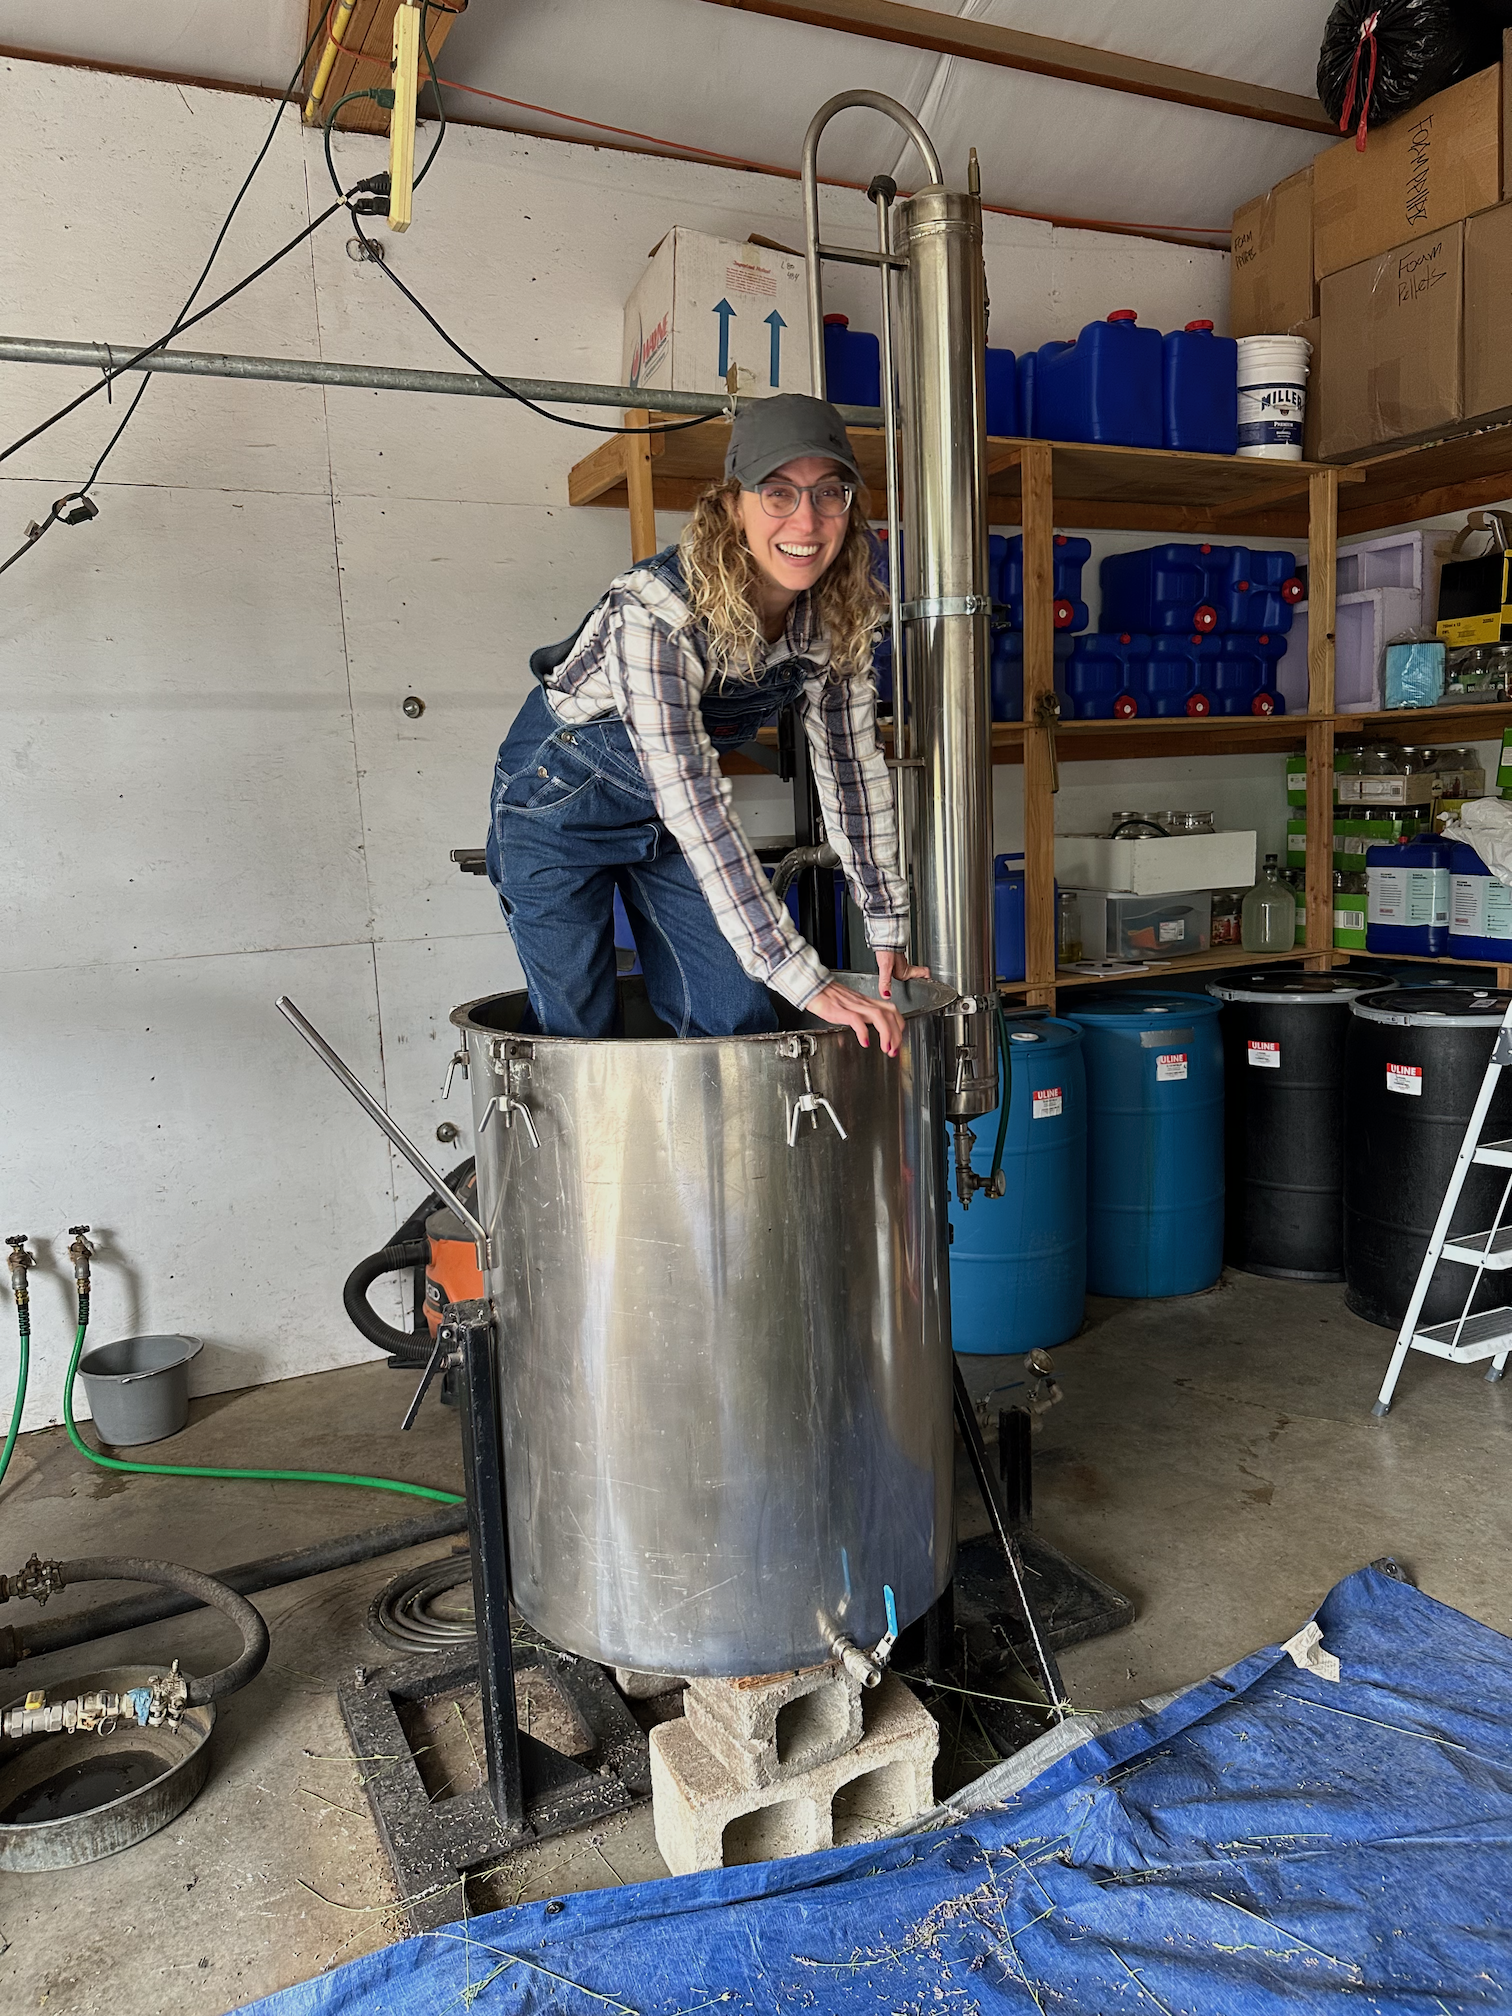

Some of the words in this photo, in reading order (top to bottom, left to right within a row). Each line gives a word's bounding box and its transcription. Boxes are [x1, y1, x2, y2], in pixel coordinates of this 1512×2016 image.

[1398, 242, 1442, 279] Foam
[1397, 264, 1447, 307] Pellets
[1250, 1041, 1275, 1051] ULINE
[1160, 1054, 1184, 1064] ULINE
[1390, 1064, 1417, 1076] ULINE
[1037, 1088, 1059, 1100] ULINE
